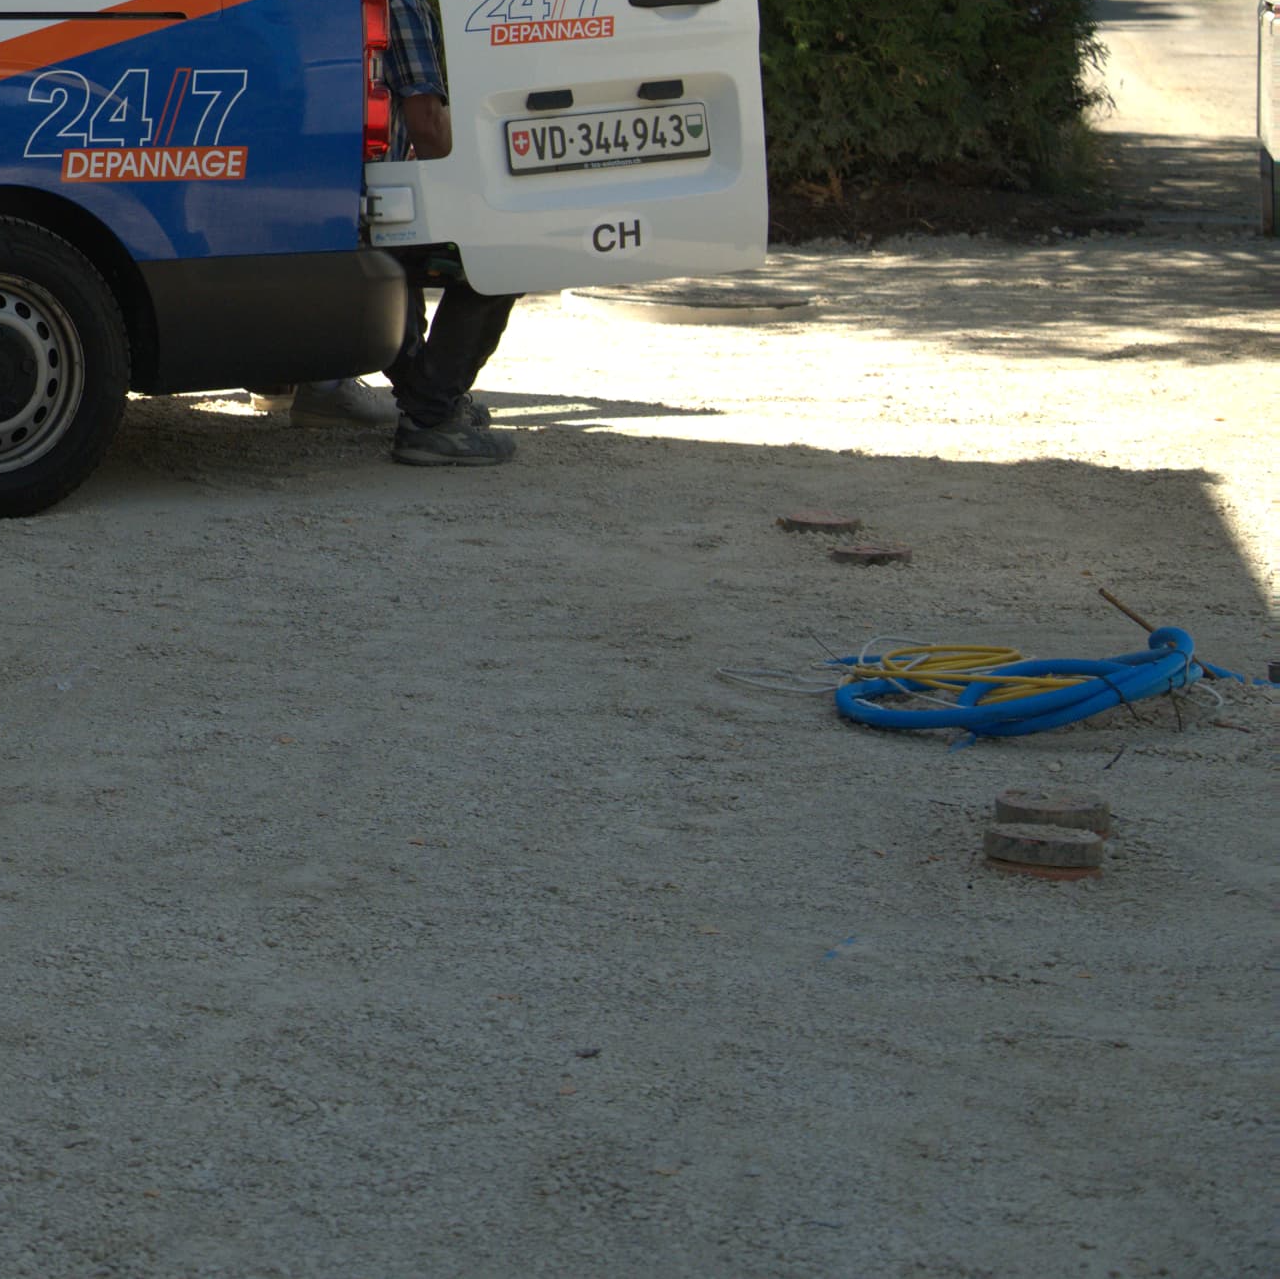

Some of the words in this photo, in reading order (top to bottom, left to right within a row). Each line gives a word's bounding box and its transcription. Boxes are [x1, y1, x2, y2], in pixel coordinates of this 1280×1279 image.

[493, 18, 612, 43] DEPANNAGE
[23, 67, 248, 158] 24/7
[65, 149, 244, 180] DEPANNAGE
[592, 218, 641, 253] CH
